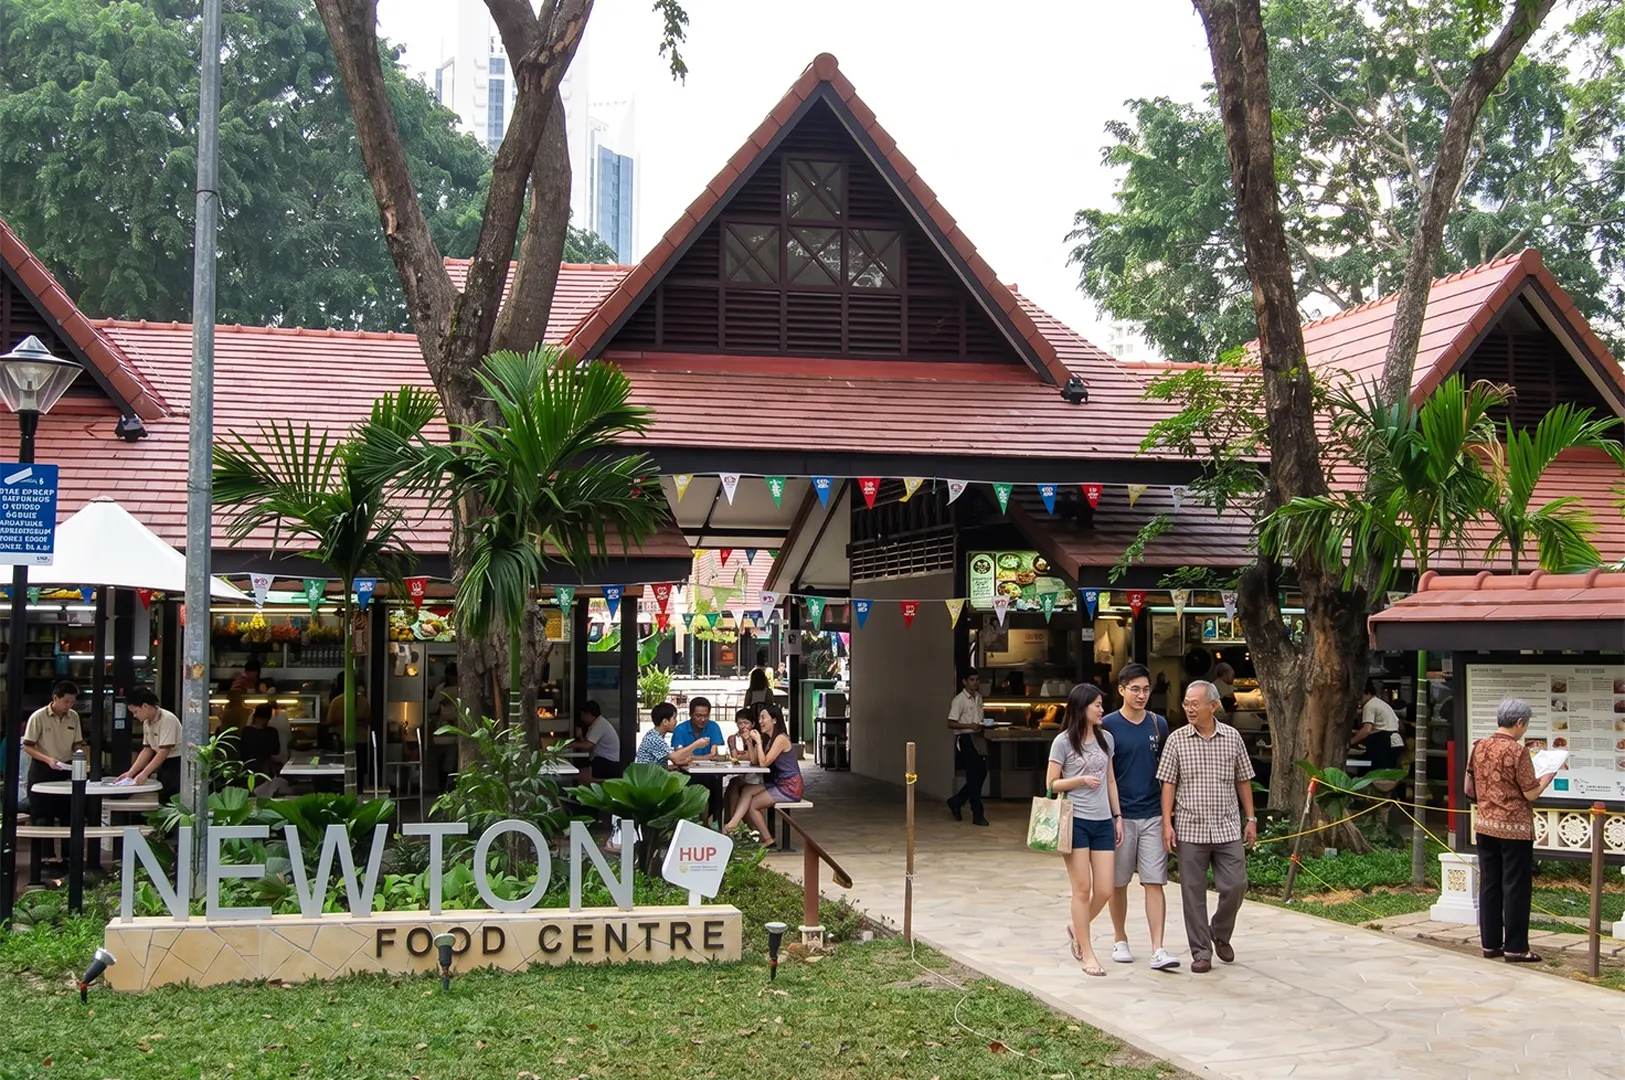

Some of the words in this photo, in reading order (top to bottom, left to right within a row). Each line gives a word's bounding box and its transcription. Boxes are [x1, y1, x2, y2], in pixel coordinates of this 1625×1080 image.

[121, 819, 636, 923] NEWTON
[679, 846, 718, 862] HUP
[376, 926, 506, 958] FOOD
[538, 920, 725, 953] CENTRE
